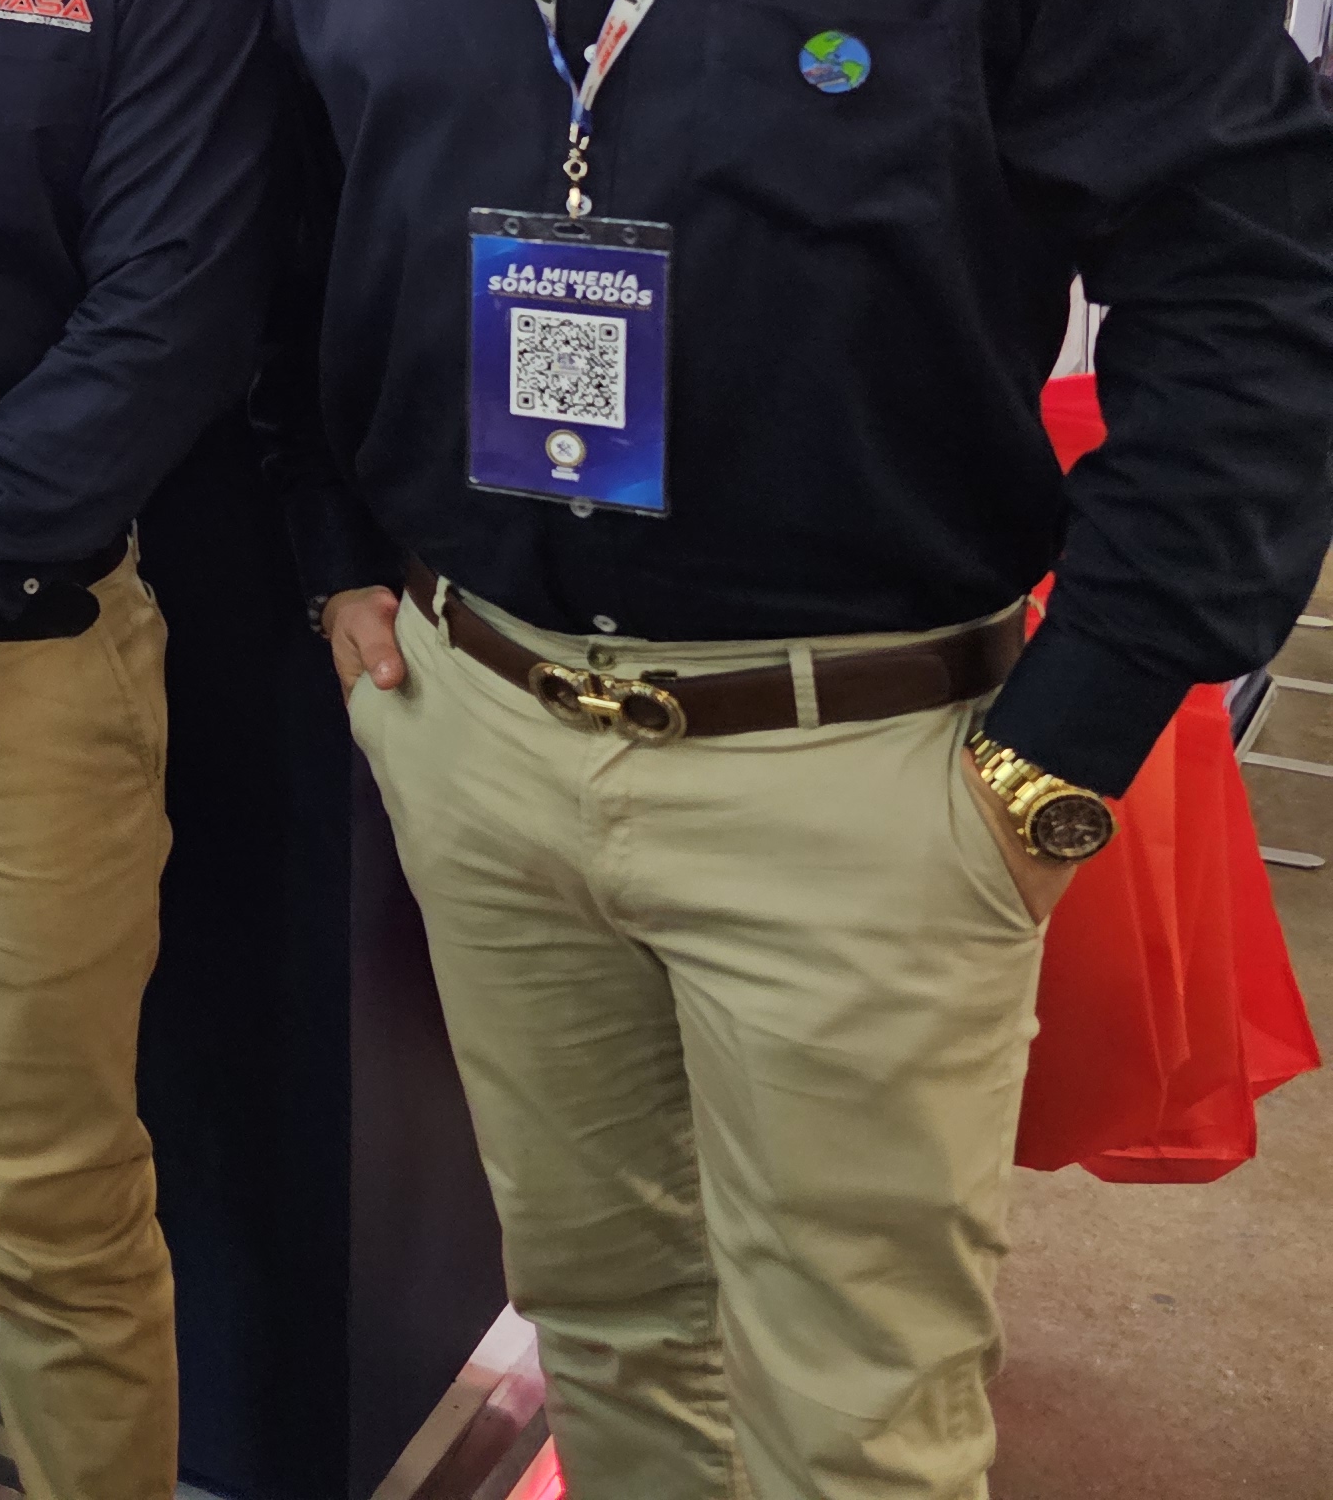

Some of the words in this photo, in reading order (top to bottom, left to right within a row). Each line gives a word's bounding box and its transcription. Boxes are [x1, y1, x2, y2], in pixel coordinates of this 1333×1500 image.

[488, 276, 567, 297] SOMOS
[574, 284, 653, 306] TODOS
[507, 263, 536, 280] LA
[542, 267, 639, 291] MINERÍA
